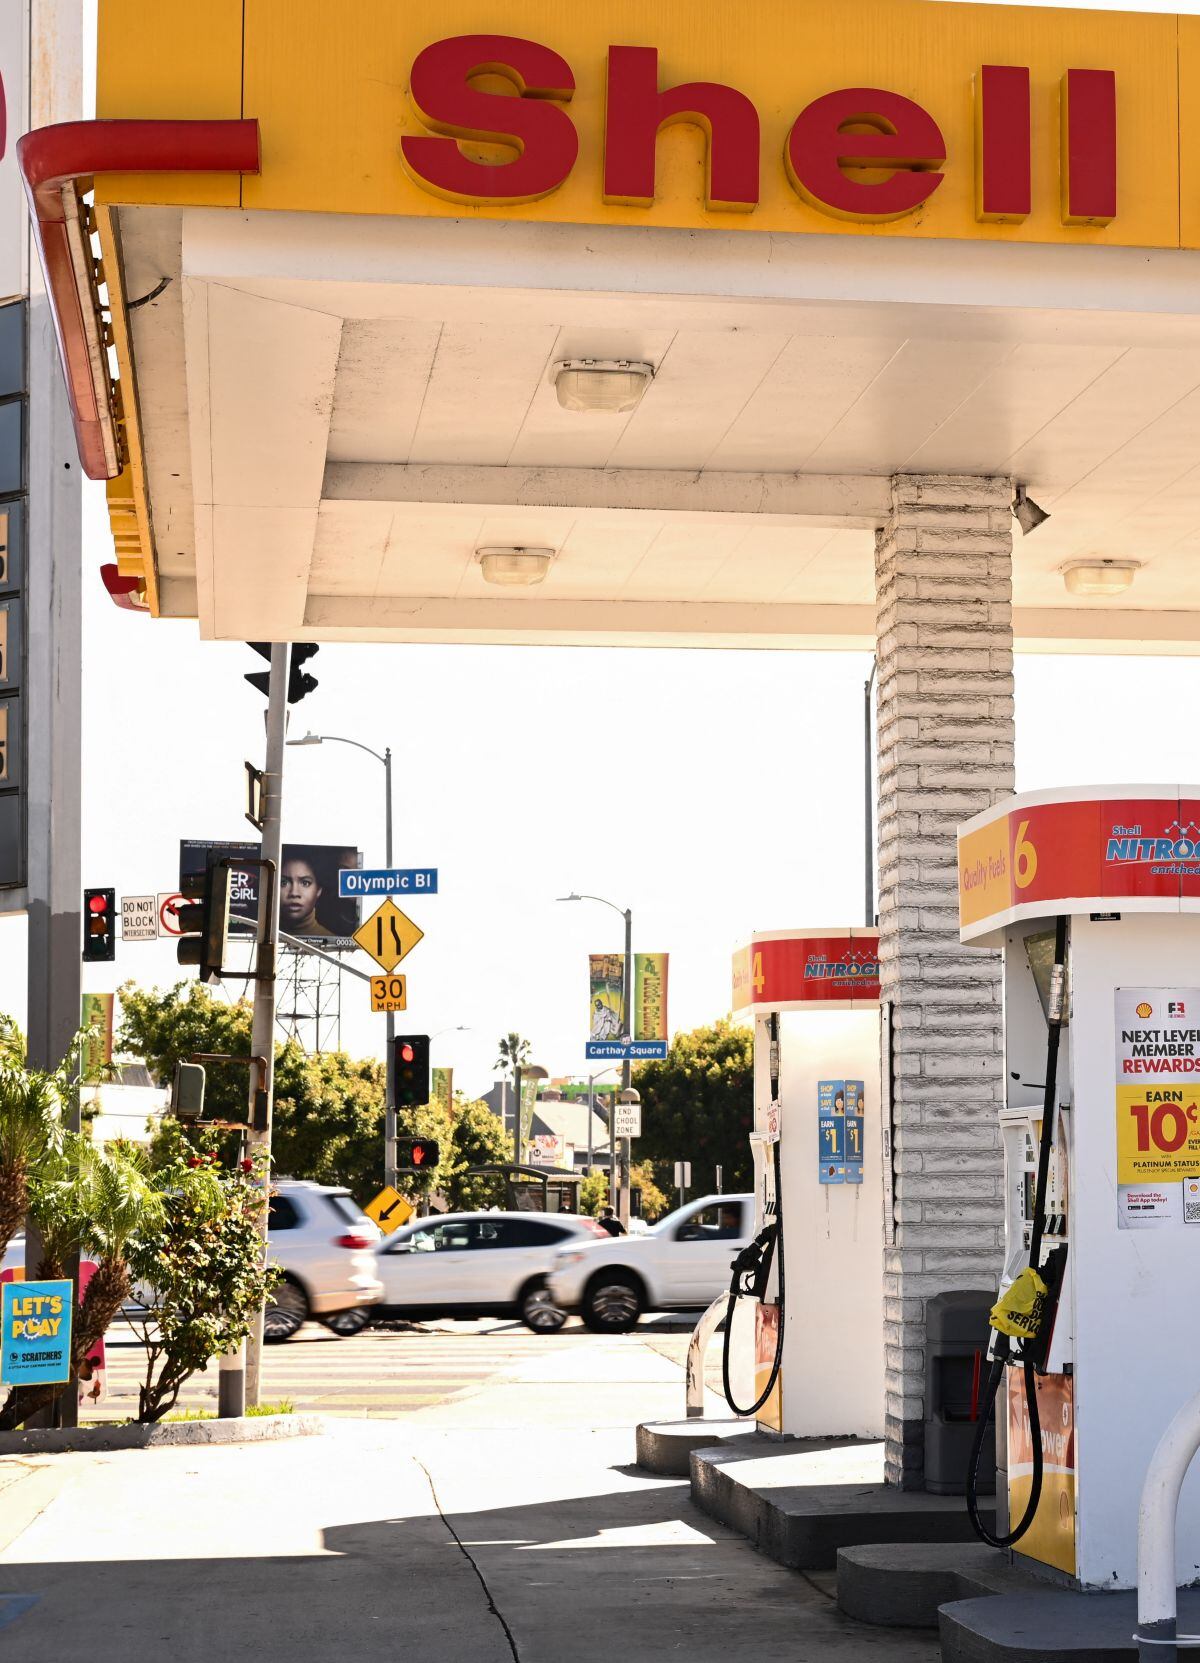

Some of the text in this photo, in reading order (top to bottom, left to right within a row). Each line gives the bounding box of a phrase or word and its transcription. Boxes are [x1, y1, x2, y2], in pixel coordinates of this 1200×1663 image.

[401, 34, 1116, 227] Shell
[1112, 824, 1142, 836] Shell
[1013, 820, 1038, 889] 6
[963, 848, 1006, 891] Quality Fuels
[346, 874, 409, 892] Olympic
[230, 888, 258, 900] GIRL
[123, 901, 153, 913] DO NOT
[123, 916, 155, 927] BLOCK
[752, 951, 765, 994] 4
[804, 963, 880, 978] NITROG
[374, 979, 403, 1000] 30
[377, 1002, 401, 1010] MPH
[639, 1005, 660, 1041] Ethiop
[1121, 1030, 1161, 1043] NEXT
[589, 1046, 662, 1057] Carthay Square
[1131, 1043, 1194, 1057] MEMBER
[820, 1085, 833, 1093] SHOP
[1146, 1091, 1183, 1102] EARN
[616, 1126, 633, 1134] ZONE
[820, 1120, 834, 1128] EARN
[1130, 1102, 1198, 1152] 10¢
[12, 1296, 62, 1316] LET'S
[12, 1317, 62, 1339] PLAY
[1007, 1310, 1040, 1335] SERV
[21, 1351, 62, 1362] SCRATCHERS
[1023, 1415, 1067, 1458] Vower
